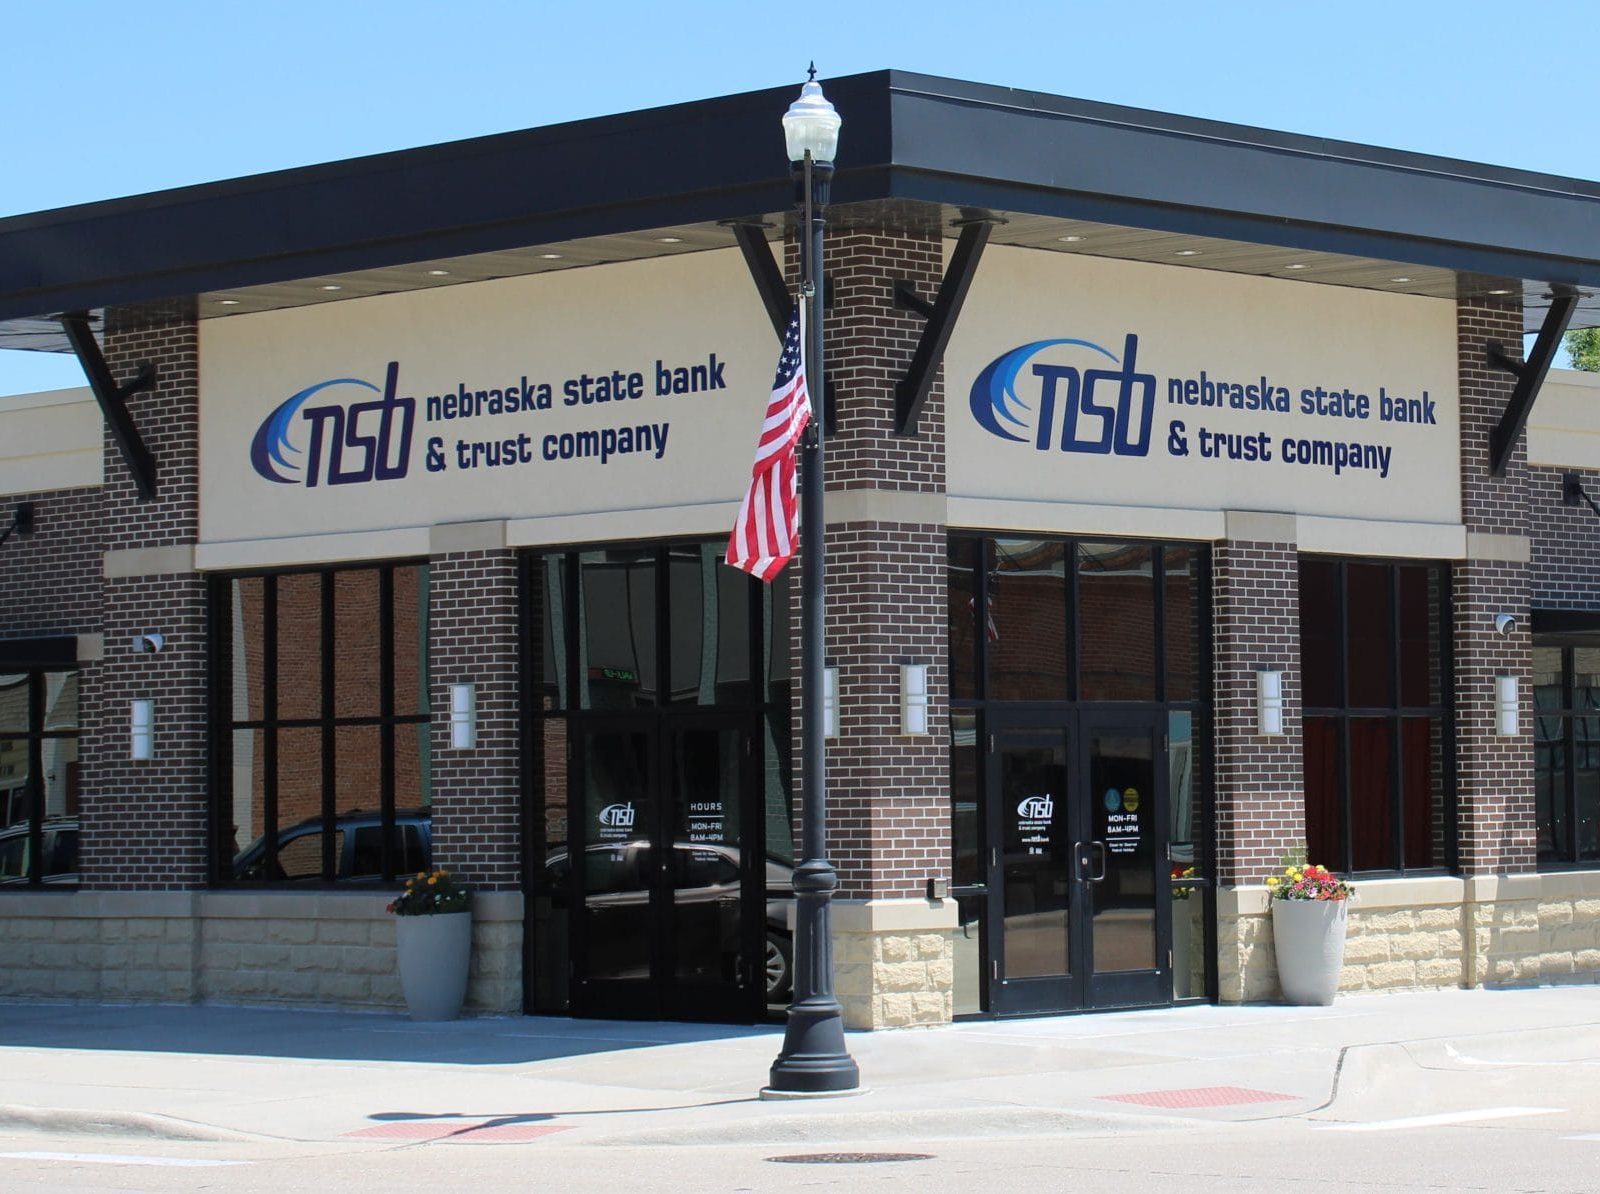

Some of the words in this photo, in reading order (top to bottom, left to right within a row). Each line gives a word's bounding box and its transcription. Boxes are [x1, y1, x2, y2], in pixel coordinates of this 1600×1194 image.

[426, 376, 553, 422] nebraska
[562, 369, 644, 407] state
[655, 352, 727, 397] bank
[1031, 333, 1157, 458] nsb
[1167, 370, 1291, 413] nebraska
[1300, 386, 1370, 420] state
[1379, 387, 1437, 425] bank
[302, 360, 417, 489] nsb
[425, 436, 448, 473] &
[455, 432, 533, 470] trust
[542, 422, 670, 465] company
[1167, 419, 1190, 457] &
[1198, 426, 1272, 462] trust
[1281, 438, 1392, 479] company
[690, 802, 722, 811] HOURS
[691, 822, 722, 830] MON-FRI
[1108, 814, 1138, 823] MON-FRI
